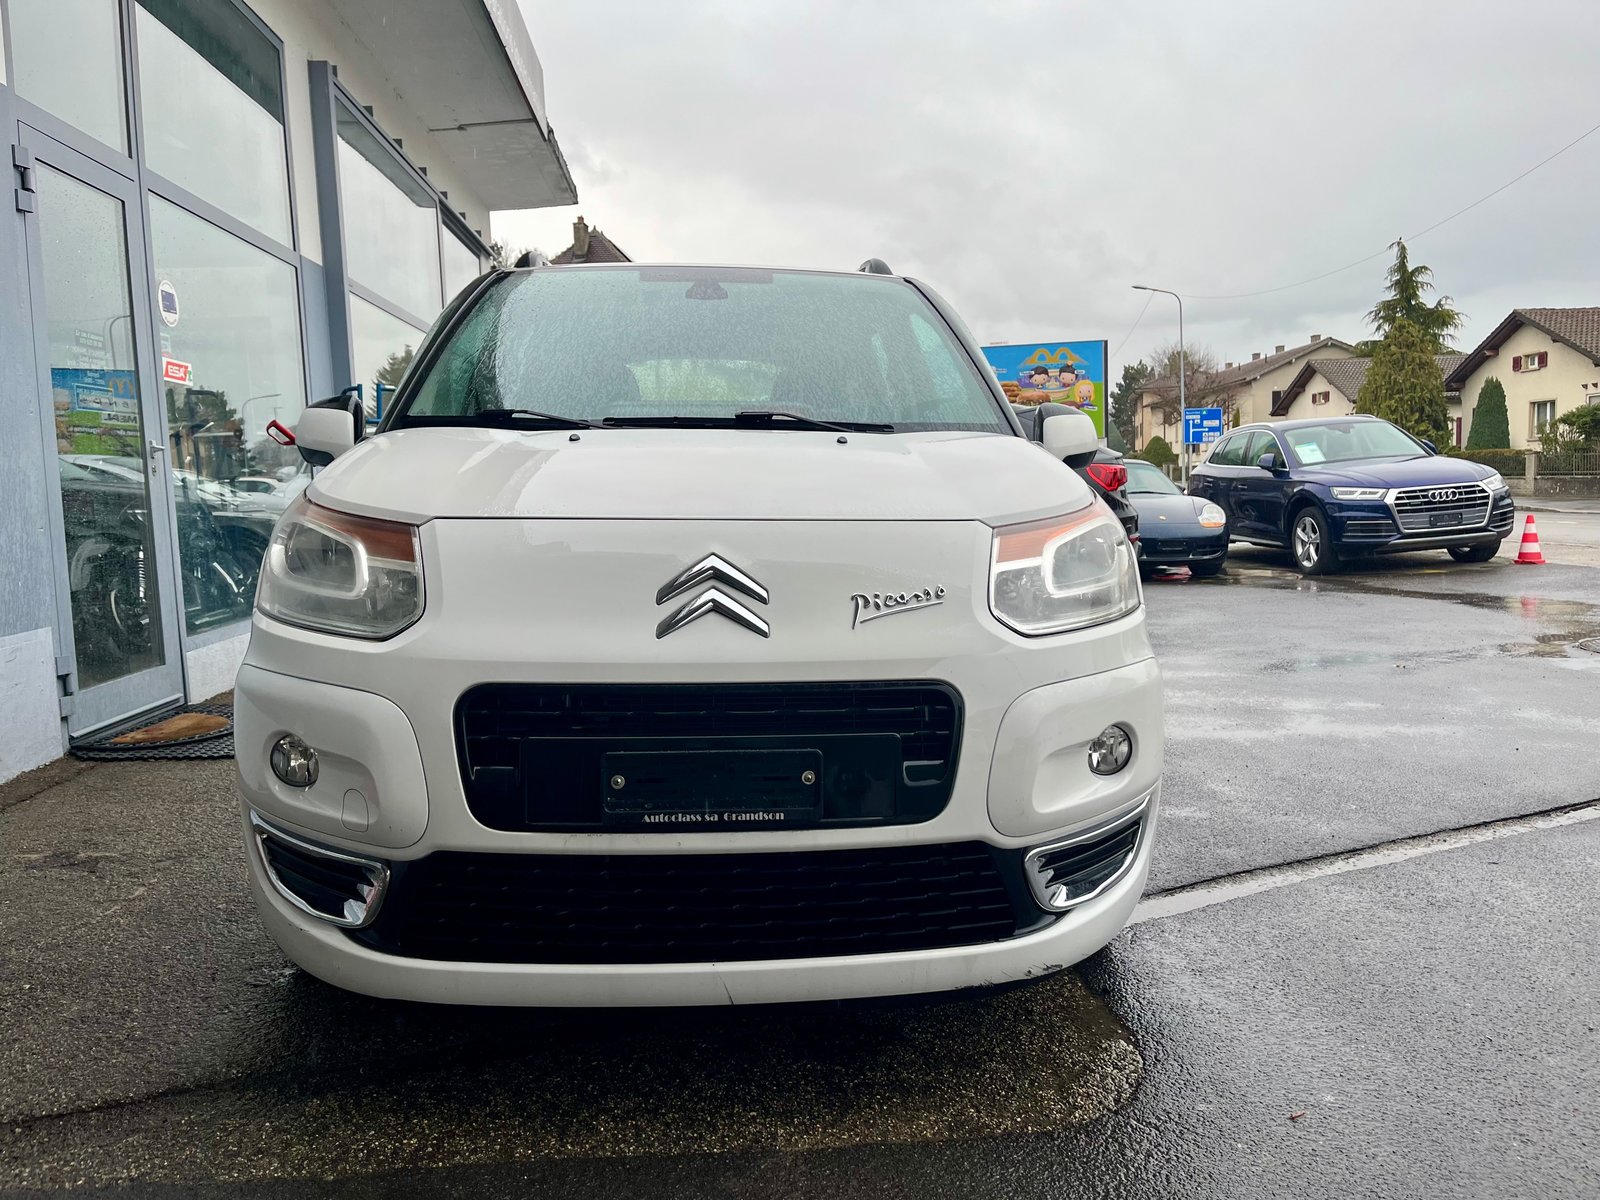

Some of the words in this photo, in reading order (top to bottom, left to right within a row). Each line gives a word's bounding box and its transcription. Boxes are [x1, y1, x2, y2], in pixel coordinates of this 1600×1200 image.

[641, 813, 702, 823] Autoclass
[704, 813, 719, 822] sa
[723, 811, 785, 821] Grandson
